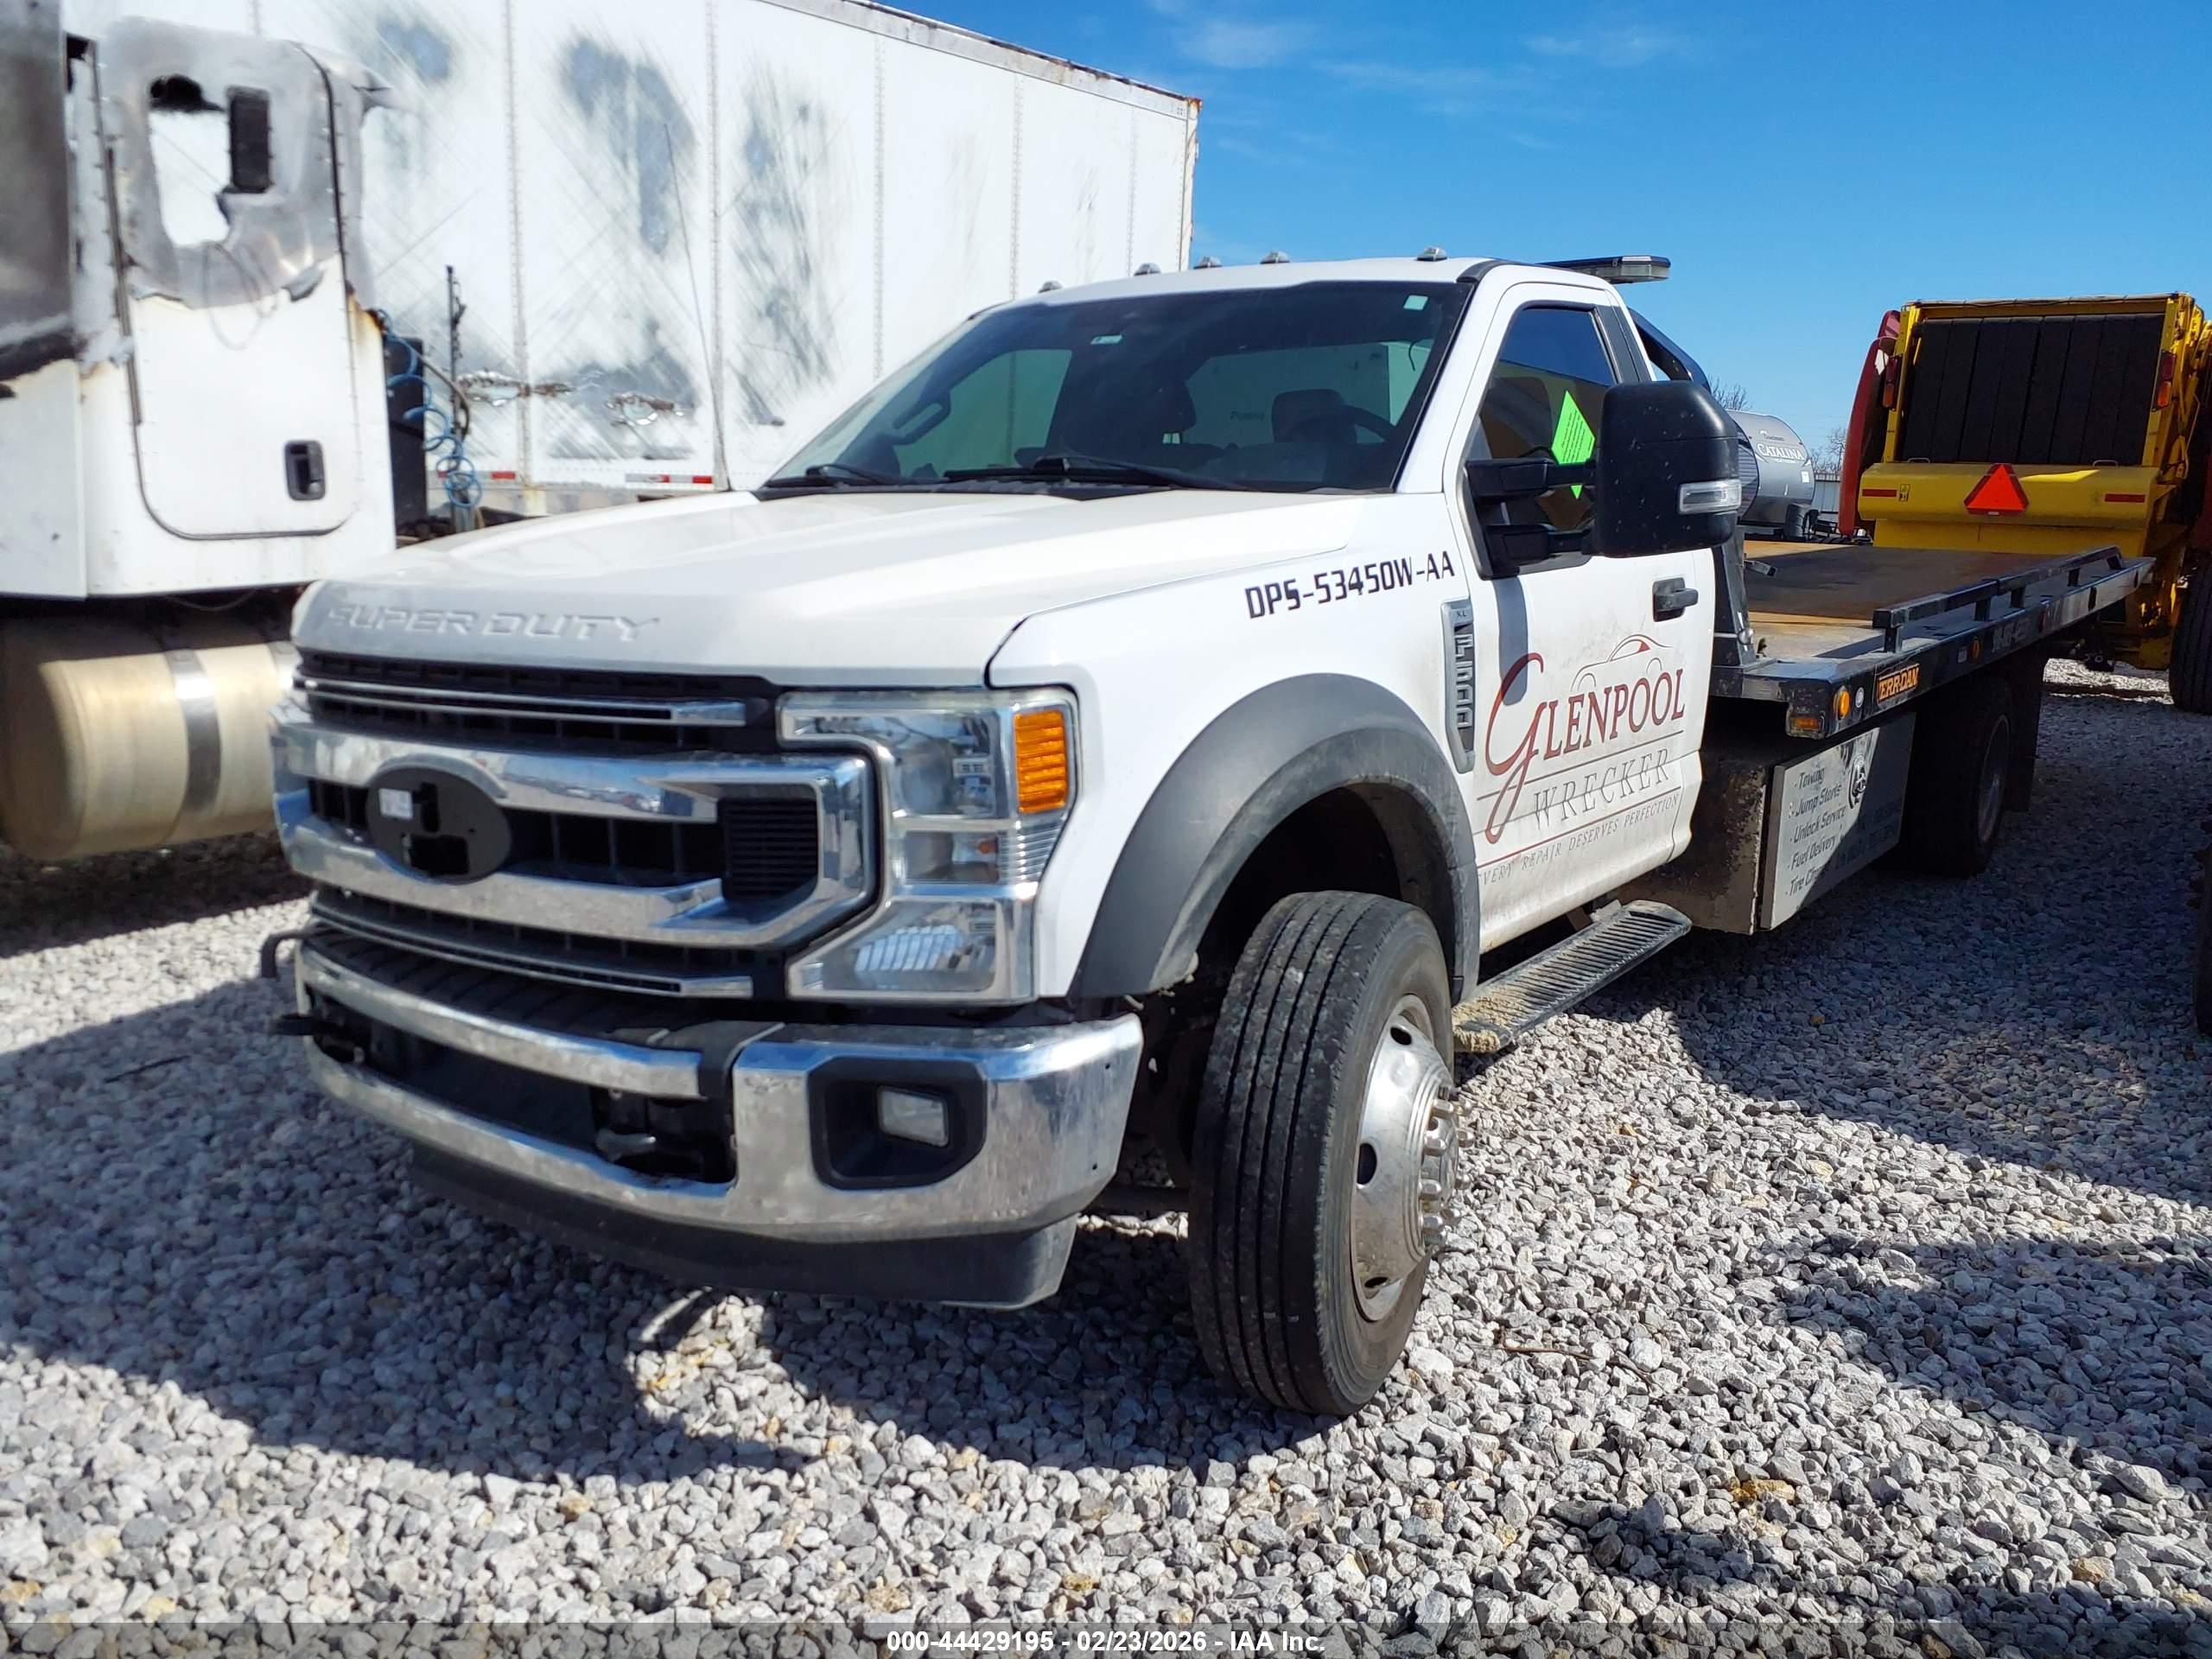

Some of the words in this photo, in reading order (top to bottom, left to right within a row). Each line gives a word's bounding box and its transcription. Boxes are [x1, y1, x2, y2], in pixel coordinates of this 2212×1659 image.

[1758, 443, 1805, 461] CATALINA
[327, 605, 479, 635] SUPER
[481, 612, 660, 643] DUTY
[1457, 609, 1467, 619] XL
[1485, 653, 1686, 844] GLENPOOL
[1533, 748, 1669, 830] WRECKER
[1798, 766, 1825, 789] Towing
[1796, 795, 1818, 817] Jump
[1819, 783, 1842, 804] Starts
[1522, 842, 1561, 870] REPAIR
[1568, 817, 1618, 851] DESERVES
[1624, 793, 1680, 828] PERFECTION
[1793, 819, 1820, 844] Unlock
[1822, 805, 1847, 828] Service
[1791, 849, 1808, 871] Fuel
[1809, 835, 1836, 861] Delivery
[1789, 874, 1805, 897] Tire
